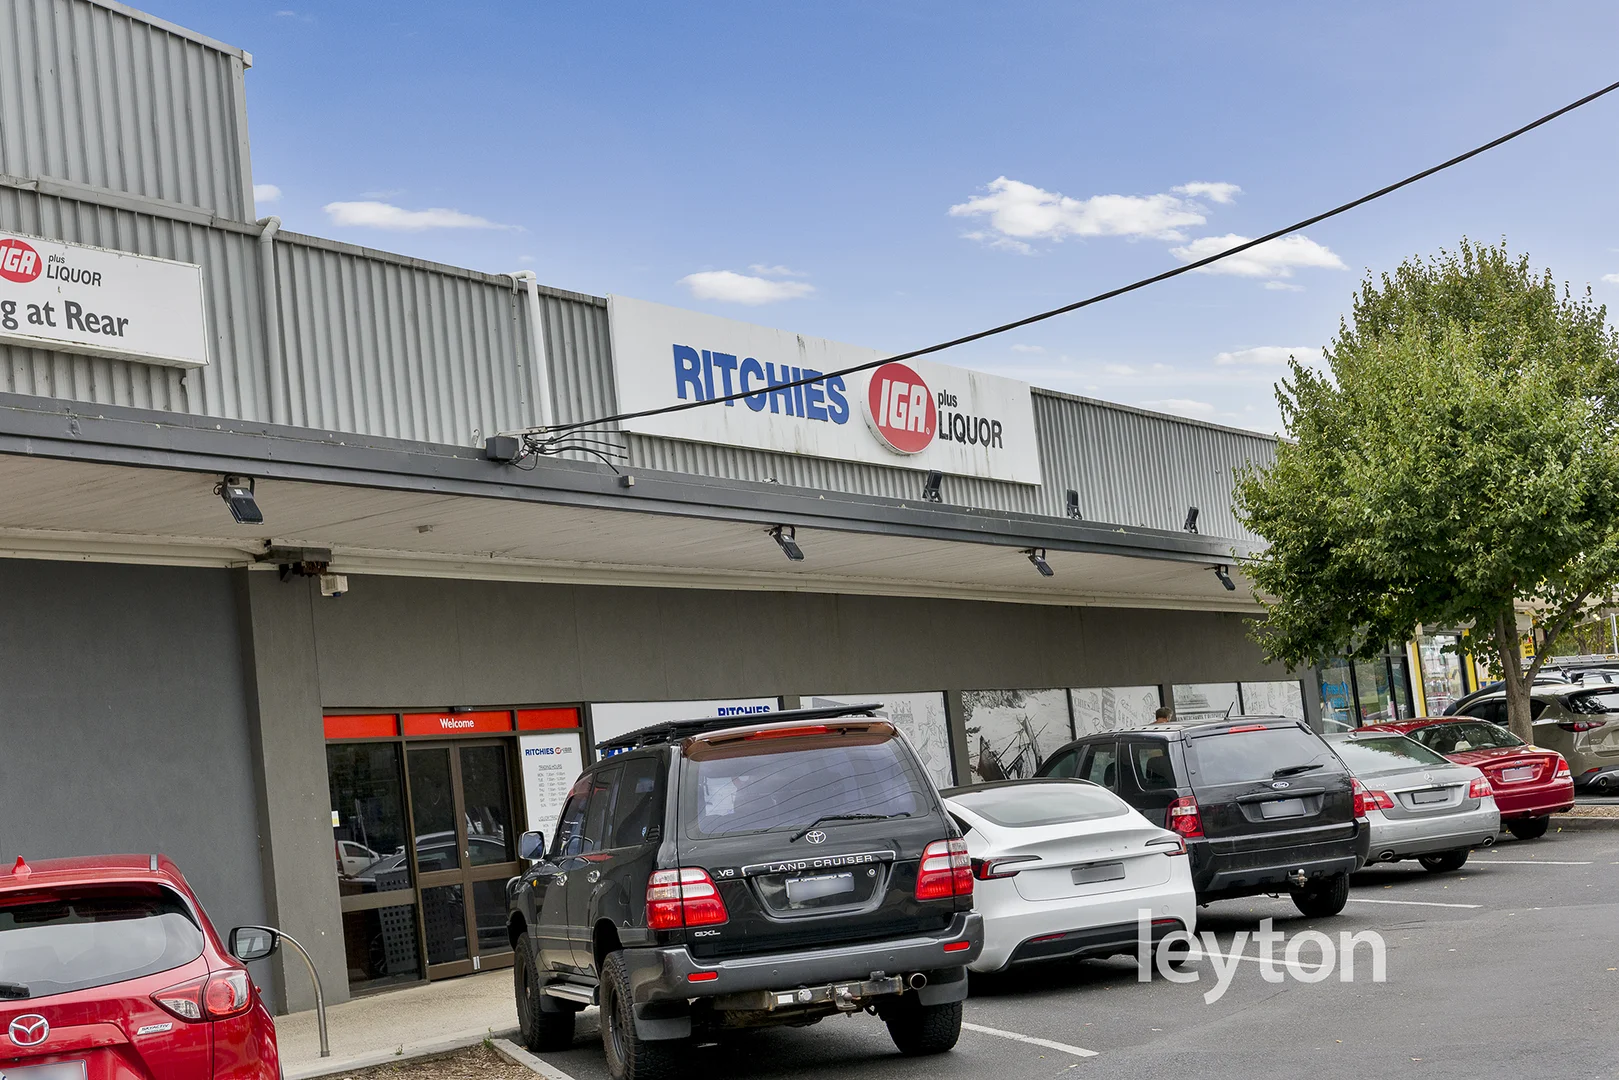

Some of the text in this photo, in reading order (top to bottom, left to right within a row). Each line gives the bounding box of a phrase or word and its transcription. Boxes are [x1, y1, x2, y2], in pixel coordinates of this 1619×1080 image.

[48, 254, 66, 264] plus
[46, 264, 102, 287] LIQUOR
[26, 301, 57, 328] at
[64, 300, 129, 337] Rear
[672, 343, 850, 426] RITCHIES
[878, 378, 928, 435] IGA
[937, 388, 958, 409] plus
[938, 410, 1004, 450] LIQUOR
[439, 717, 475, 729] Welcome
[525, 747, 555, 756] RITCHIES
[717, 854, 874, 878] V8 LAND CRUISER
